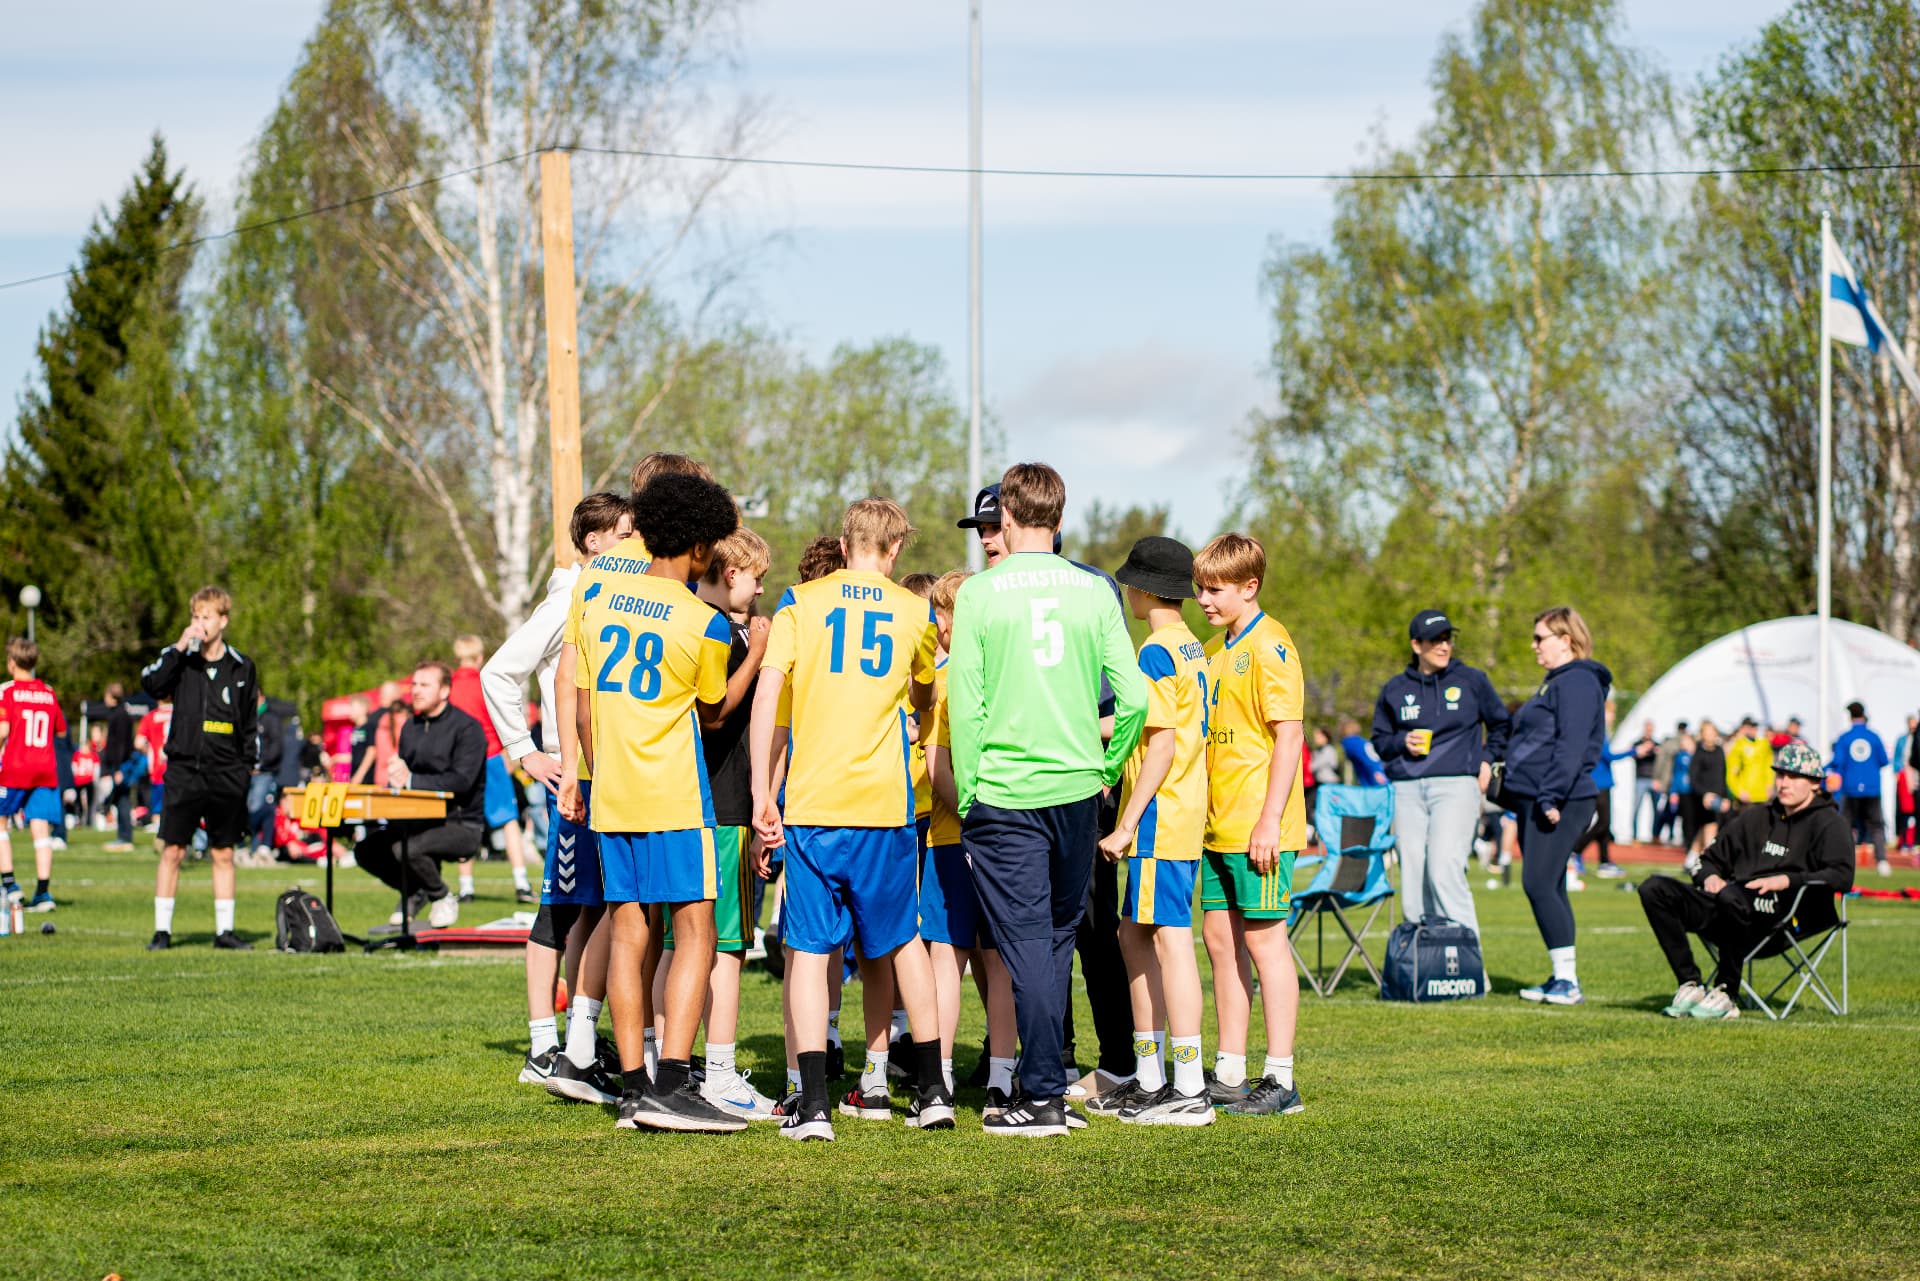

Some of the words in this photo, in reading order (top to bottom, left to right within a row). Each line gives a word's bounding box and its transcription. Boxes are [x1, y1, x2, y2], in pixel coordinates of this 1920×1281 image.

[608, 593, 674, 622] IGBRUDE
[841, 583, 883, 602] REPO
[825, 607, 893, 678] 15
[1030, 597, 1065, 667] 5
[597, 624, 663, 701] 28
[21, 708, 50, 748] 10
[1427, 978, 1477, 997] macron
